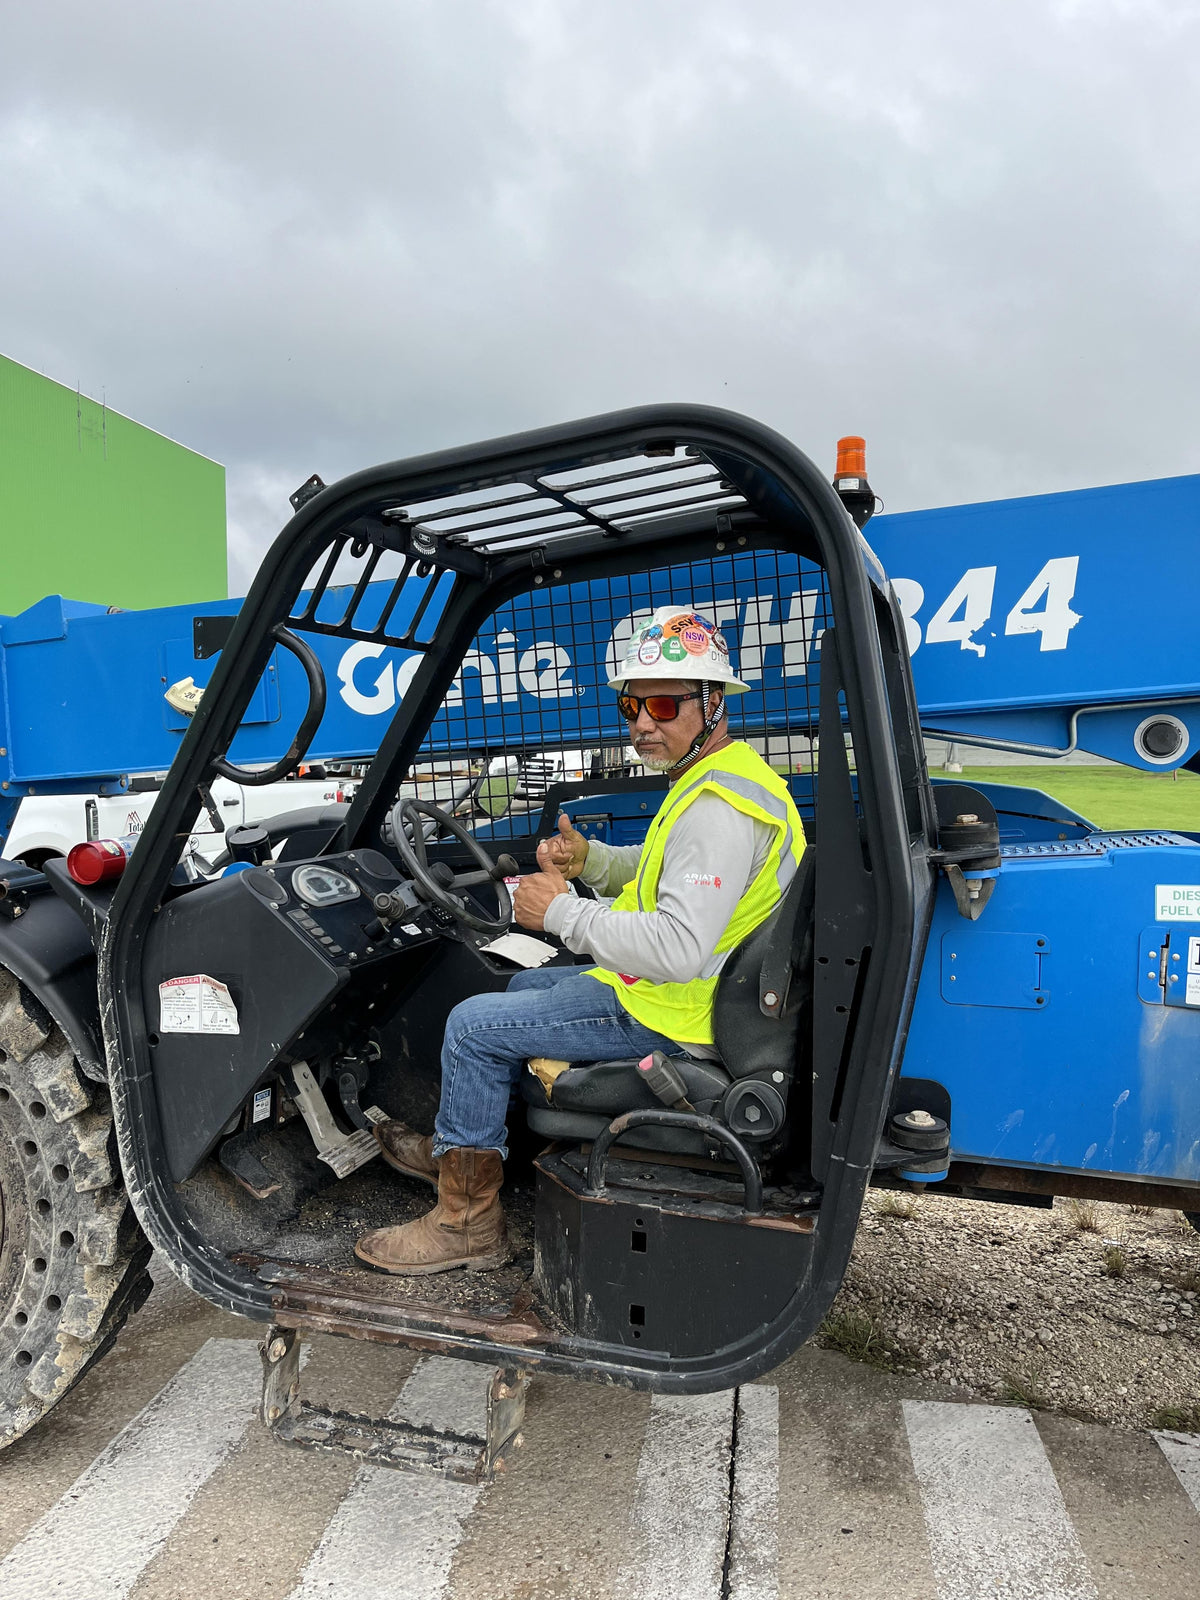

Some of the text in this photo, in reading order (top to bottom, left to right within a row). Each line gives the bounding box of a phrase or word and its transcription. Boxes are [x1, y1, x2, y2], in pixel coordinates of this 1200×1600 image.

[685, 631, 705, 642] NSW
[337, 627, 574, 715] Genie
[683, 872, 715, 881] ARIAT
[1173, 890, 1200, 901] DIES
[1160, 905, 1193, 916] FUEL
[168, 977, 200, 986] DANGER
